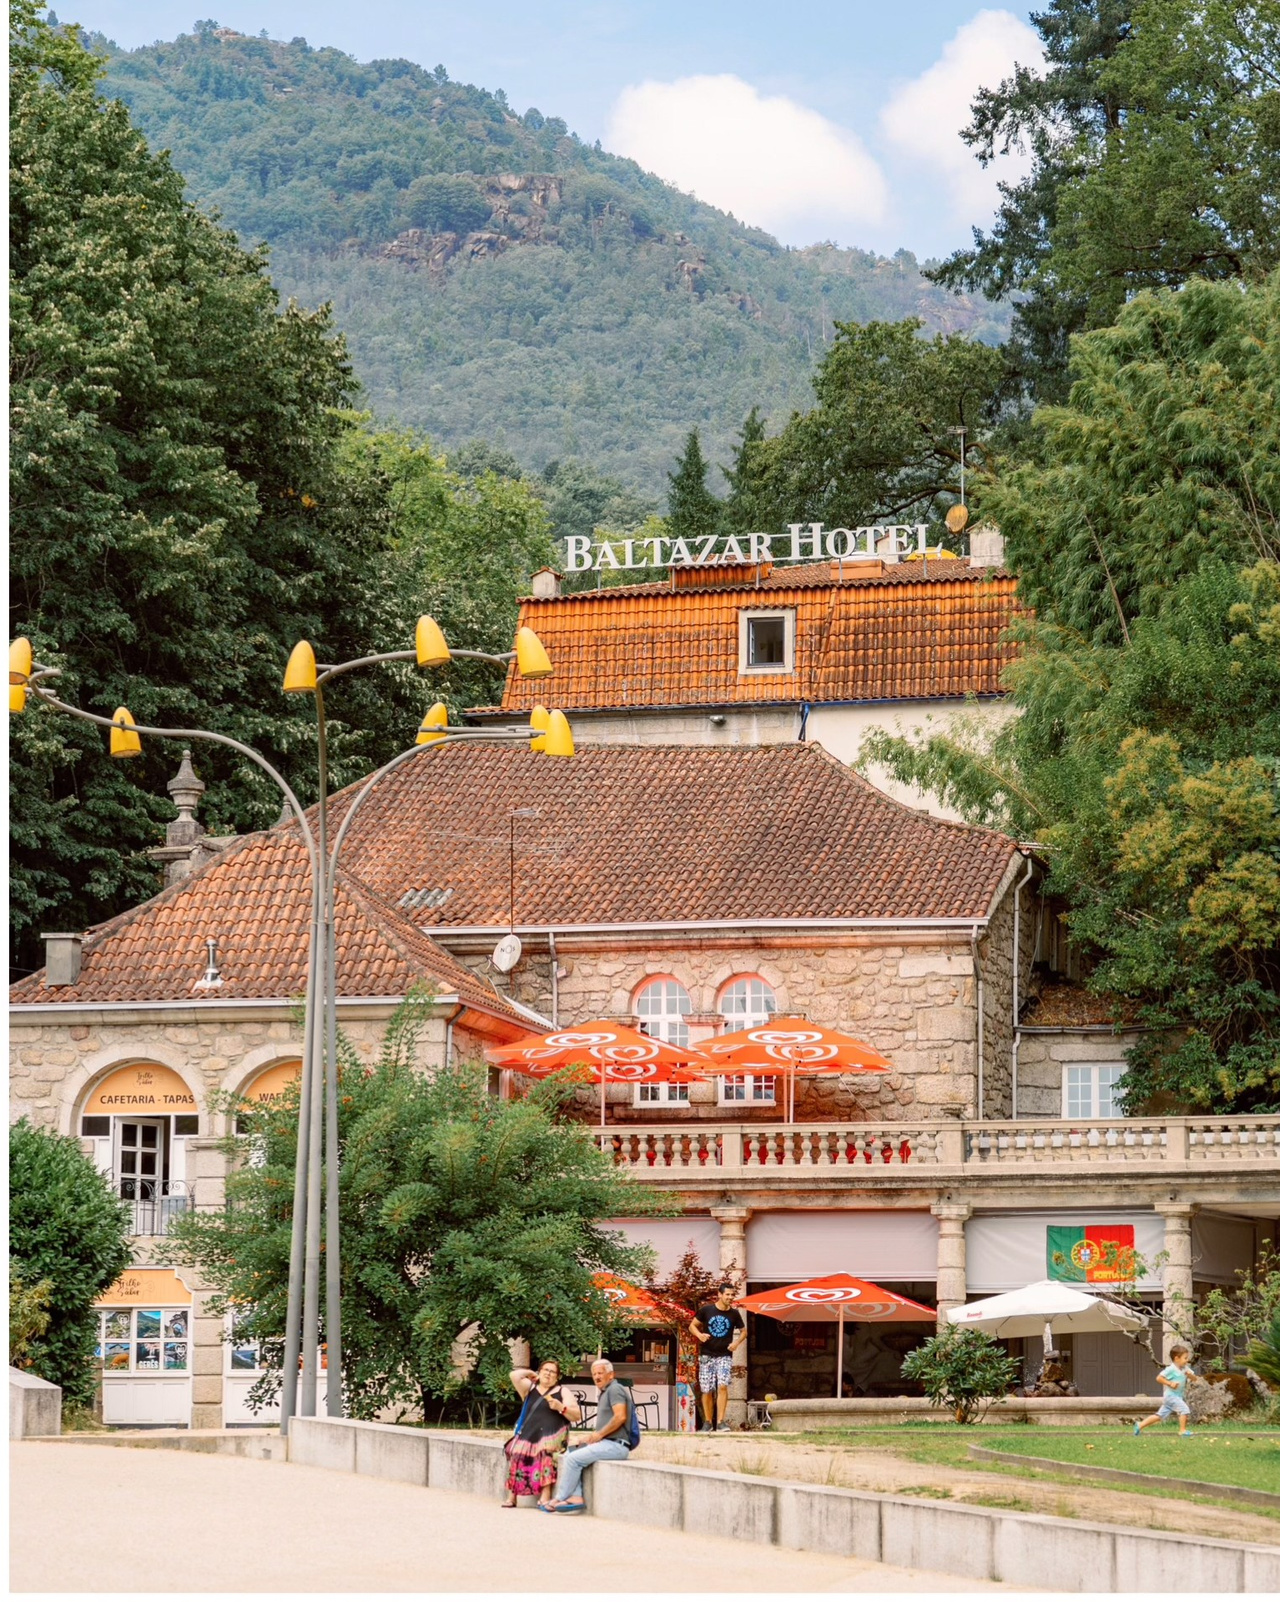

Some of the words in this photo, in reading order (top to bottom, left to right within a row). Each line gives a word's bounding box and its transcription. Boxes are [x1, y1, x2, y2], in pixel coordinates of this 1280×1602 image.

[563, 532, 774, 572] BALTAZAR
[787, 522, 943, 560] HOTEL
[100, 1095, 155, 1104] CAFETARIA
[163, 1094, 195, 1104] TAPAS
